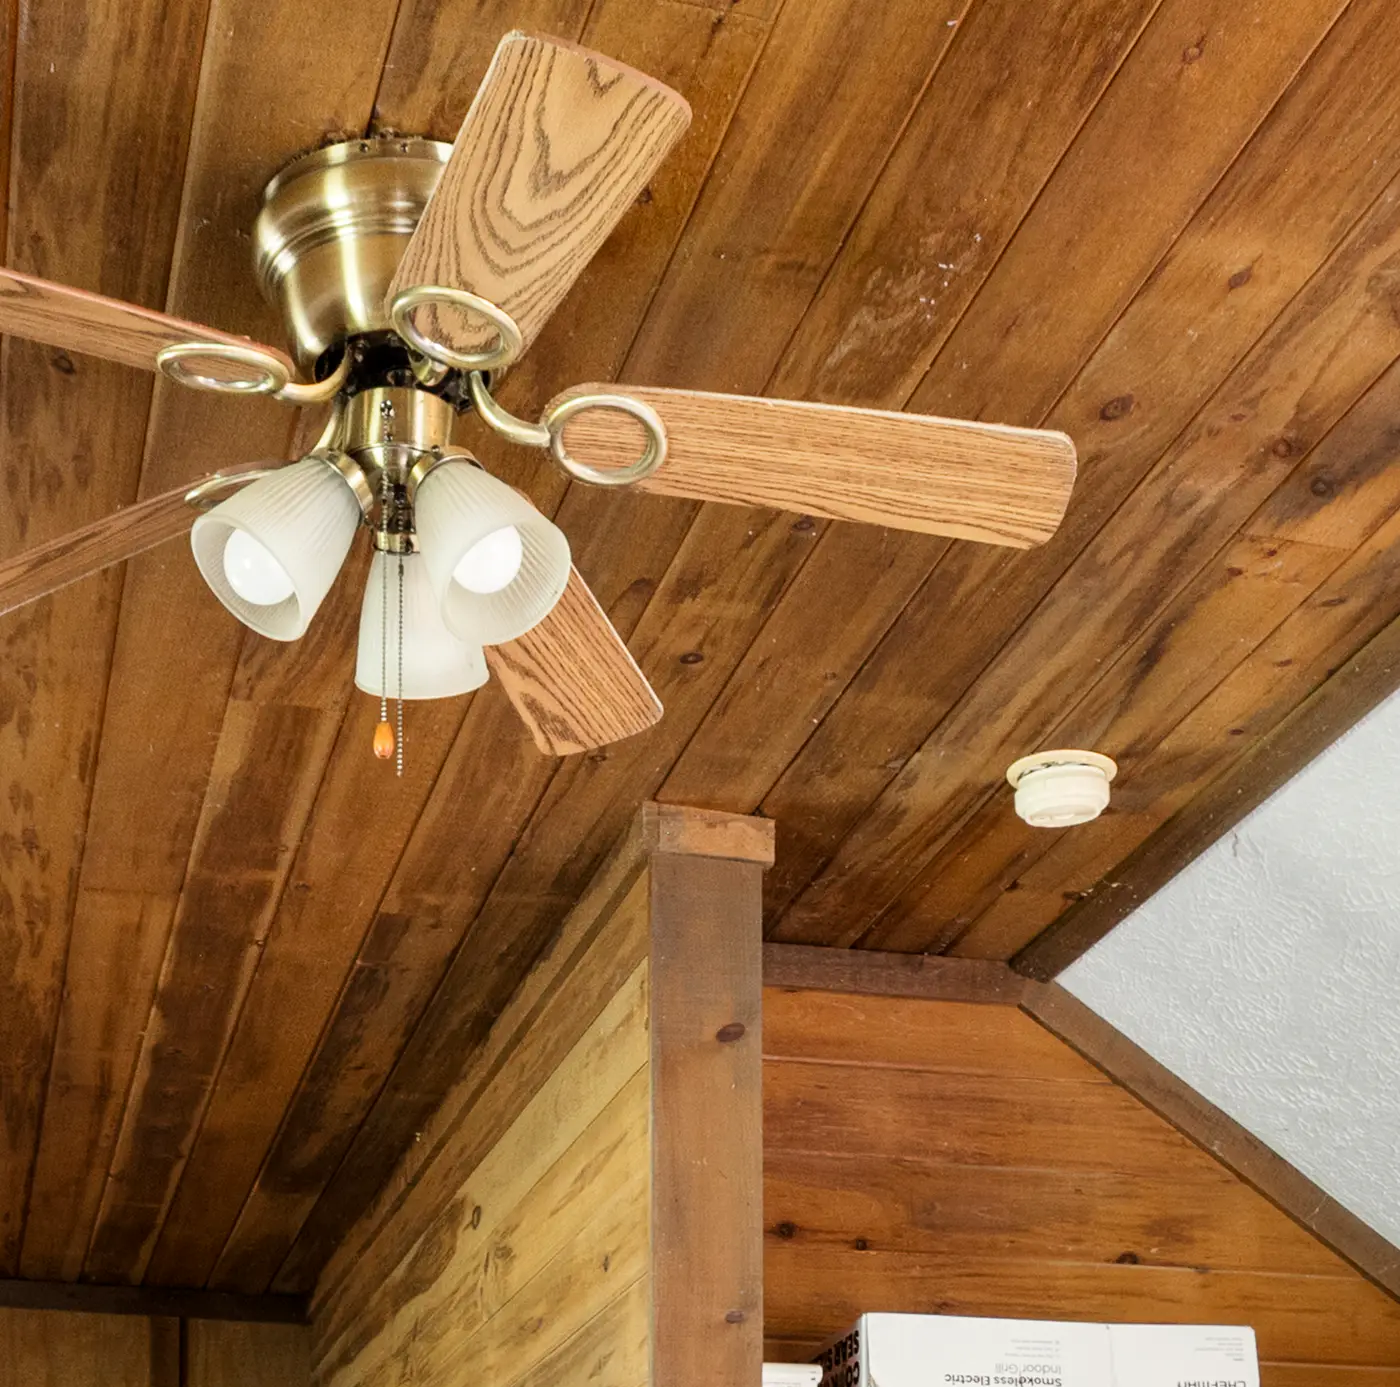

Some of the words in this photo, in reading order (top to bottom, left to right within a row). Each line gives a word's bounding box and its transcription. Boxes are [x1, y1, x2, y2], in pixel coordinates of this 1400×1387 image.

[994, 1363, 1018, 1374] Grill
[1022, 1363, 1062, 1374] Indoor
[944, 1373, 990, 1386] Electric
[993, 1376, 1062, 1387] Smokeless
